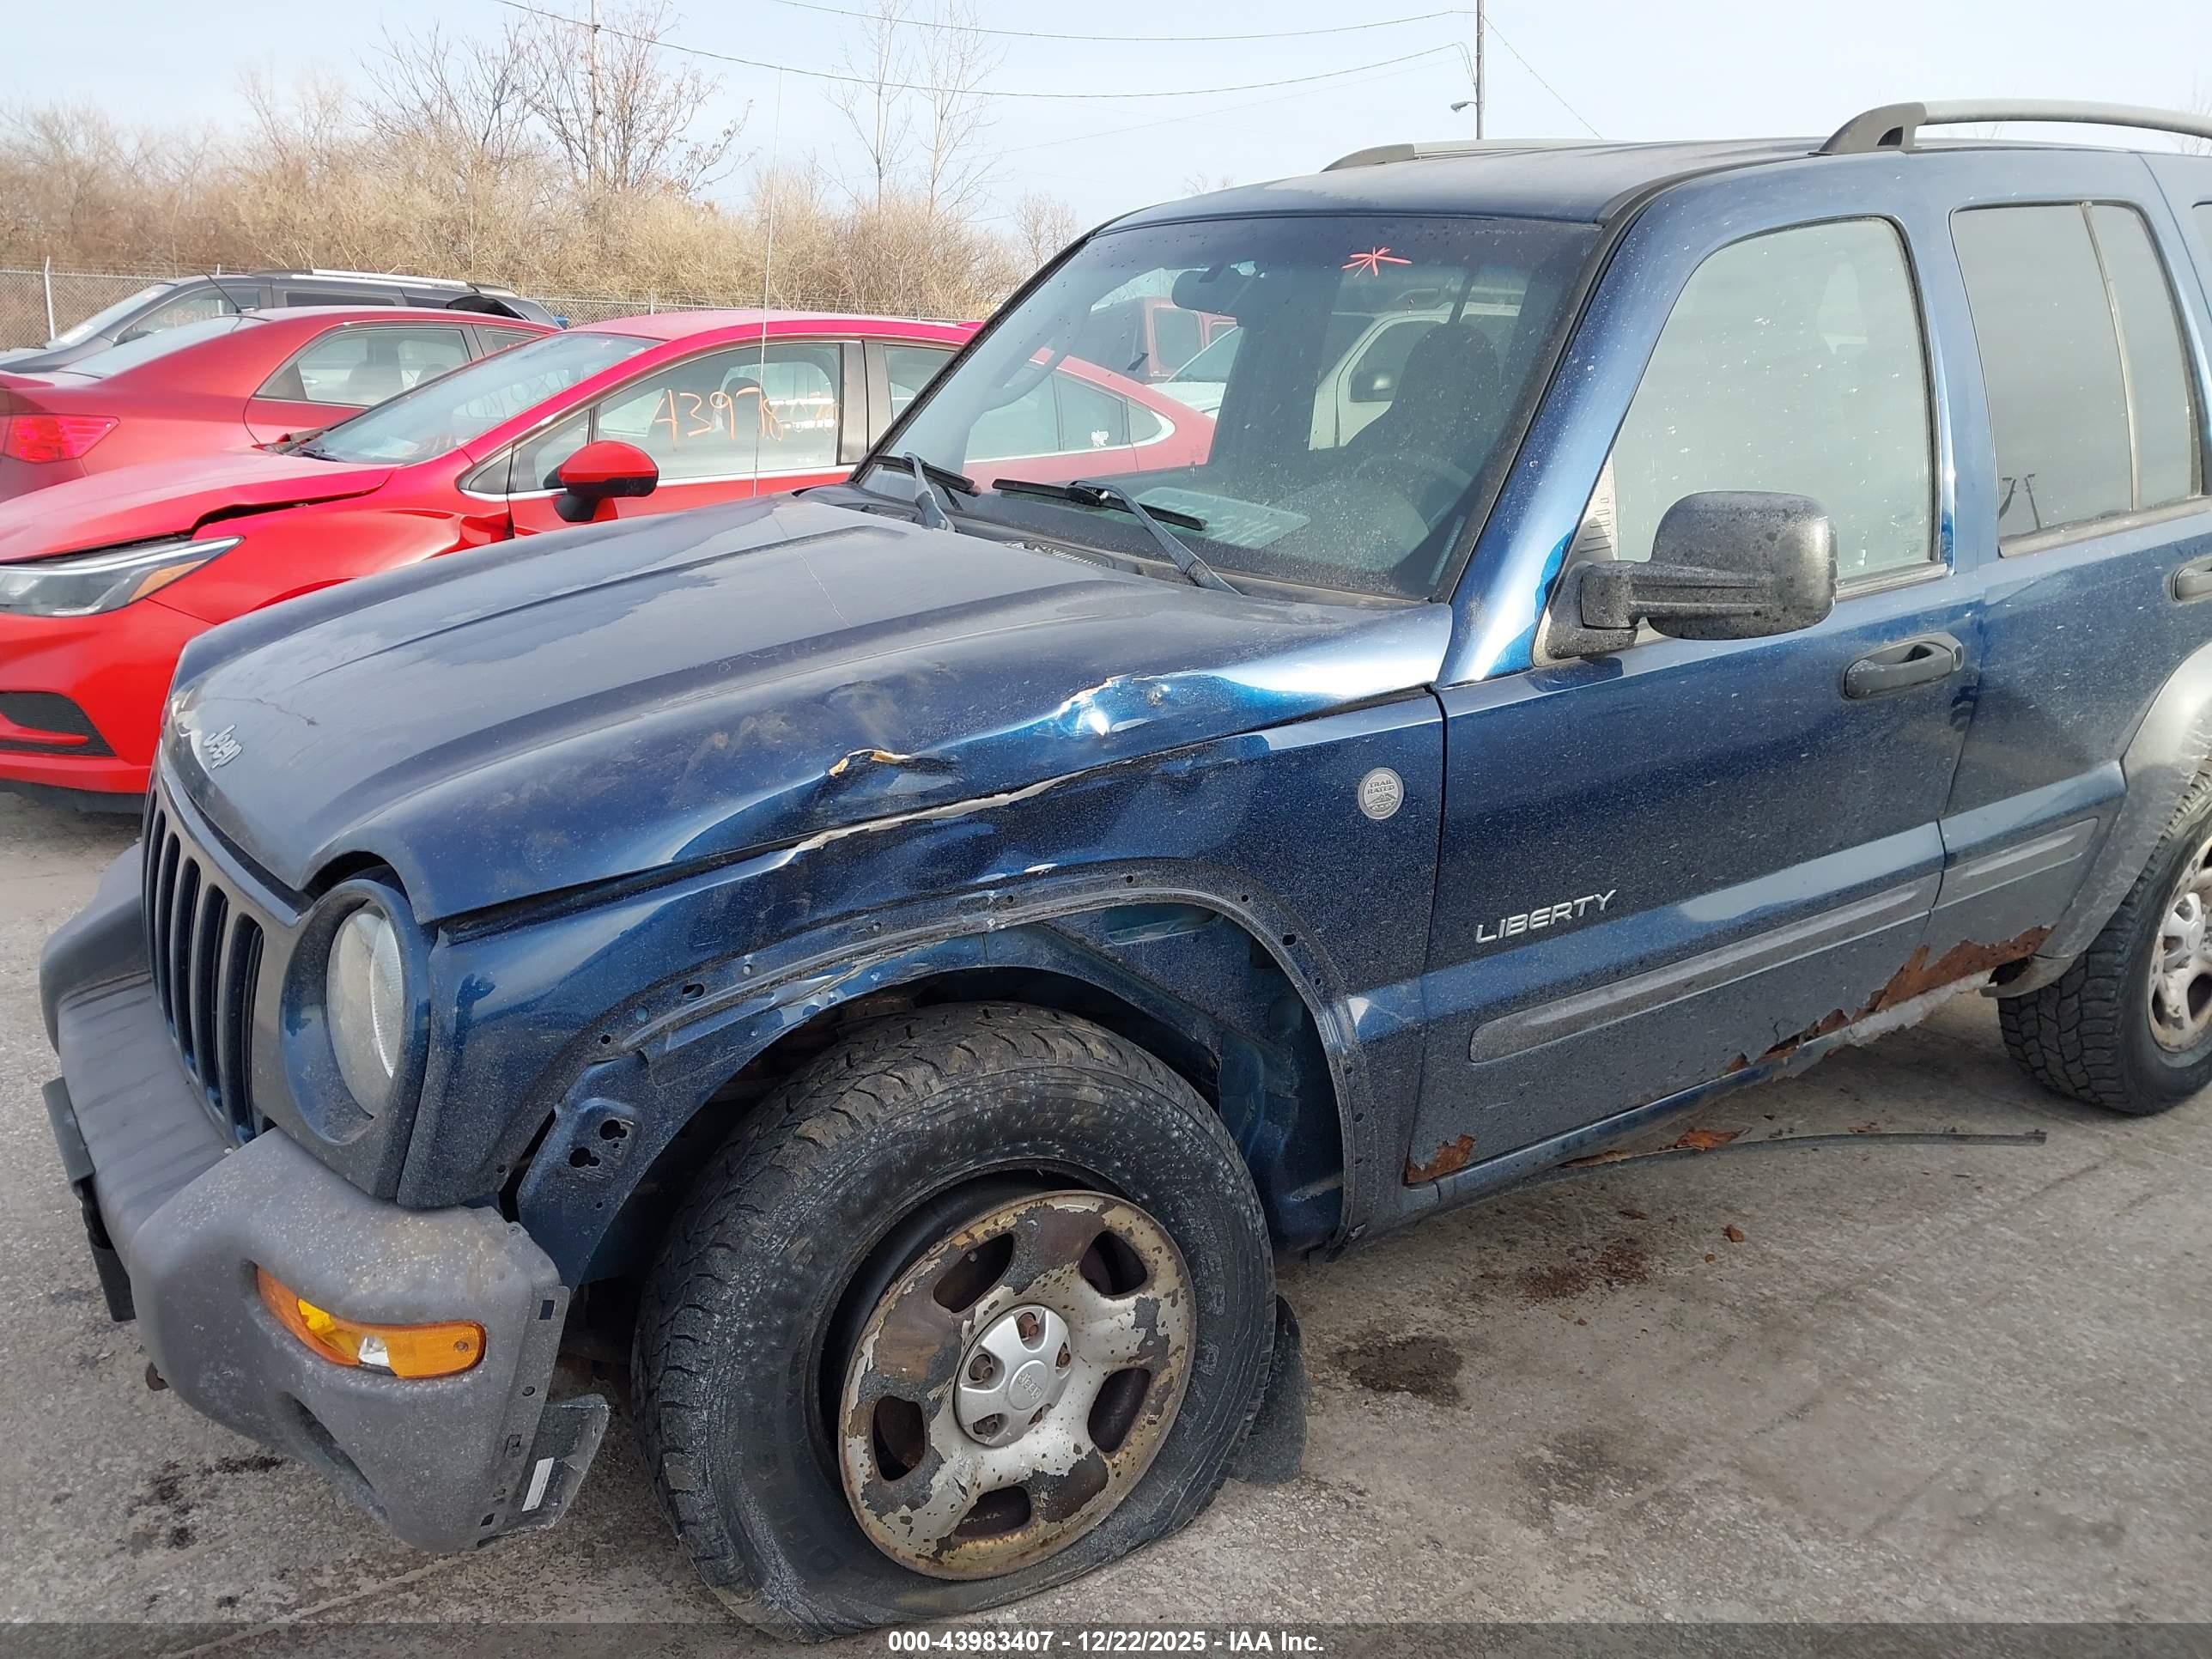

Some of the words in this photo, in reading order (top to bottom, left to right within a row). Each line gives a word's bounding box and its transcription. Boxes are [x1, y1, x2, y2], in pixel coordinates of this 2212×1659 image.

[203, 724, 243, 770] Jeep
[1367, 785, 1395, 795] RATED
[1368, 779, 1394, 788] TRAIL
[1475, 889, 1617, 944] LIBERTY
[1018, 1373, 1042, 1400] Jeep
